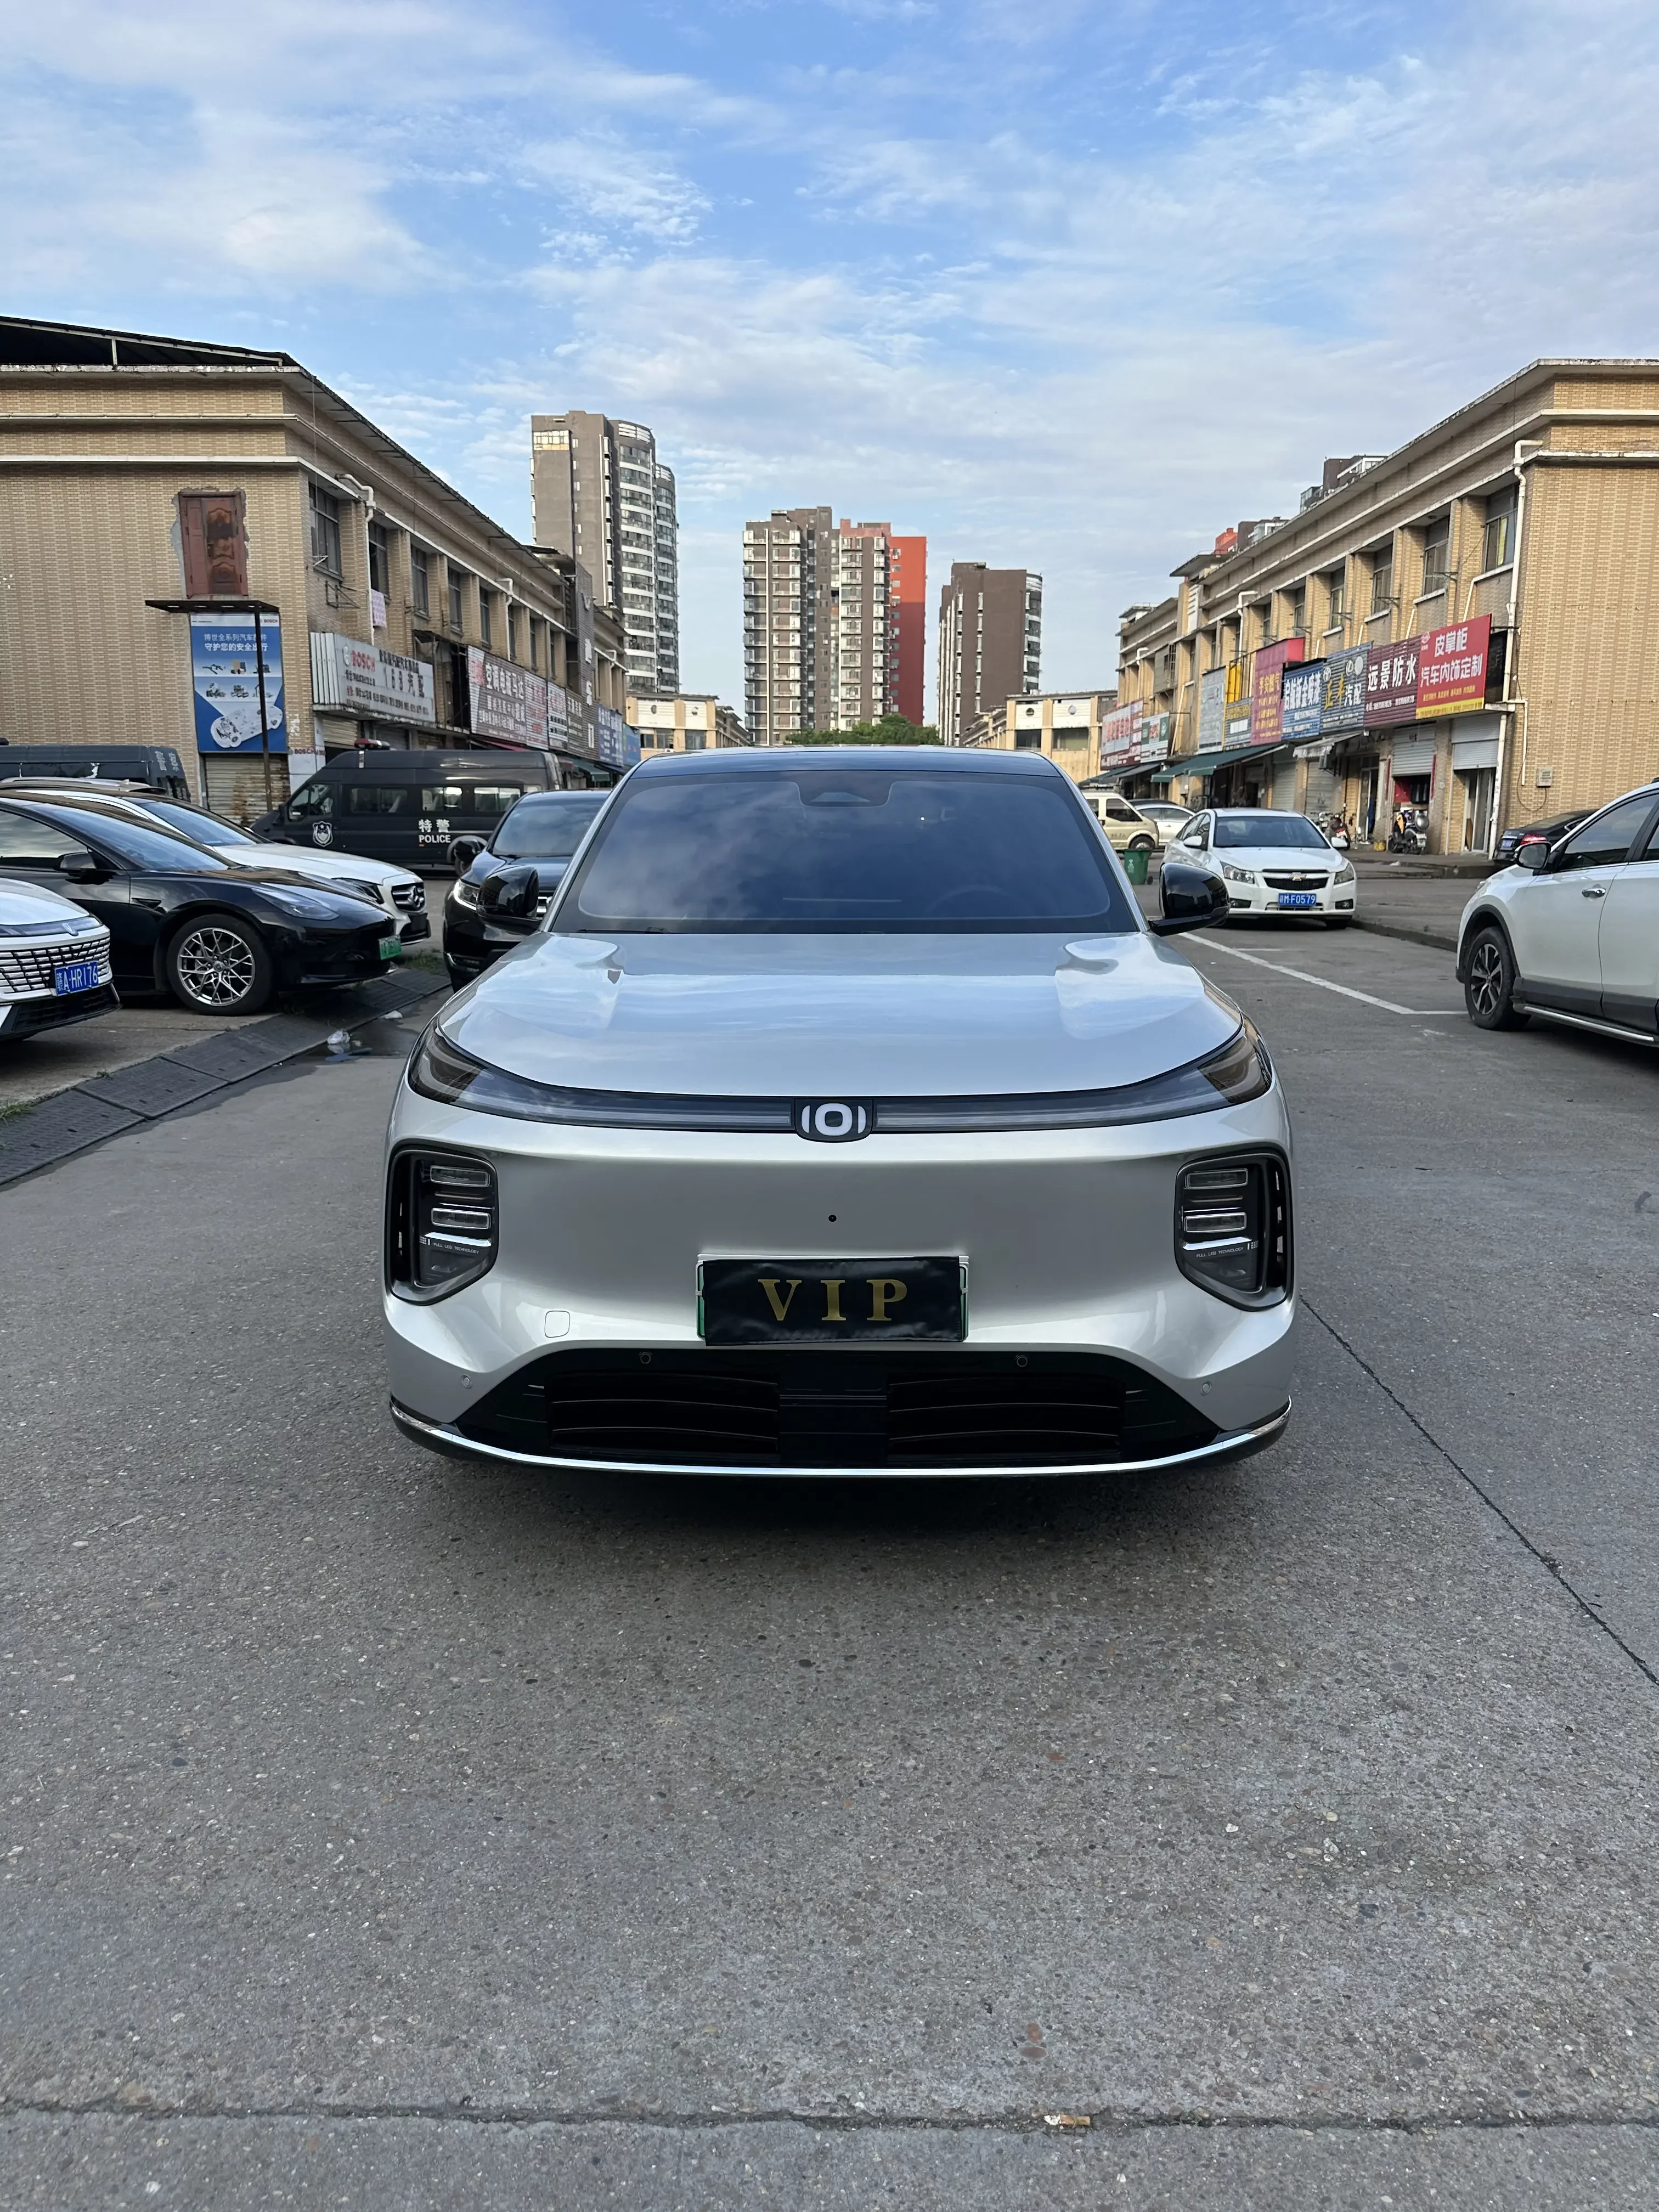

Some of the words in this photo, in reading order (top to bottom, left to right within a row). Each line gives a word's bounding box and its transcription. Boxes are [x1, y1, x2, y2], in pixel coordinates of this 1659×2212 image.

[1435, 627, 1468, 657] 皮掌柜
[351, 650, 375, 672] BOSCH
[1367, 653, 1417, 692] 远景防水
[1420, 653, 1483, 688] 汽车内饰定制
[419, 819, 450, 833] 特警
[419, 834, 451, 843] POLICE
[758, 1279, 907, 1321] VIP
